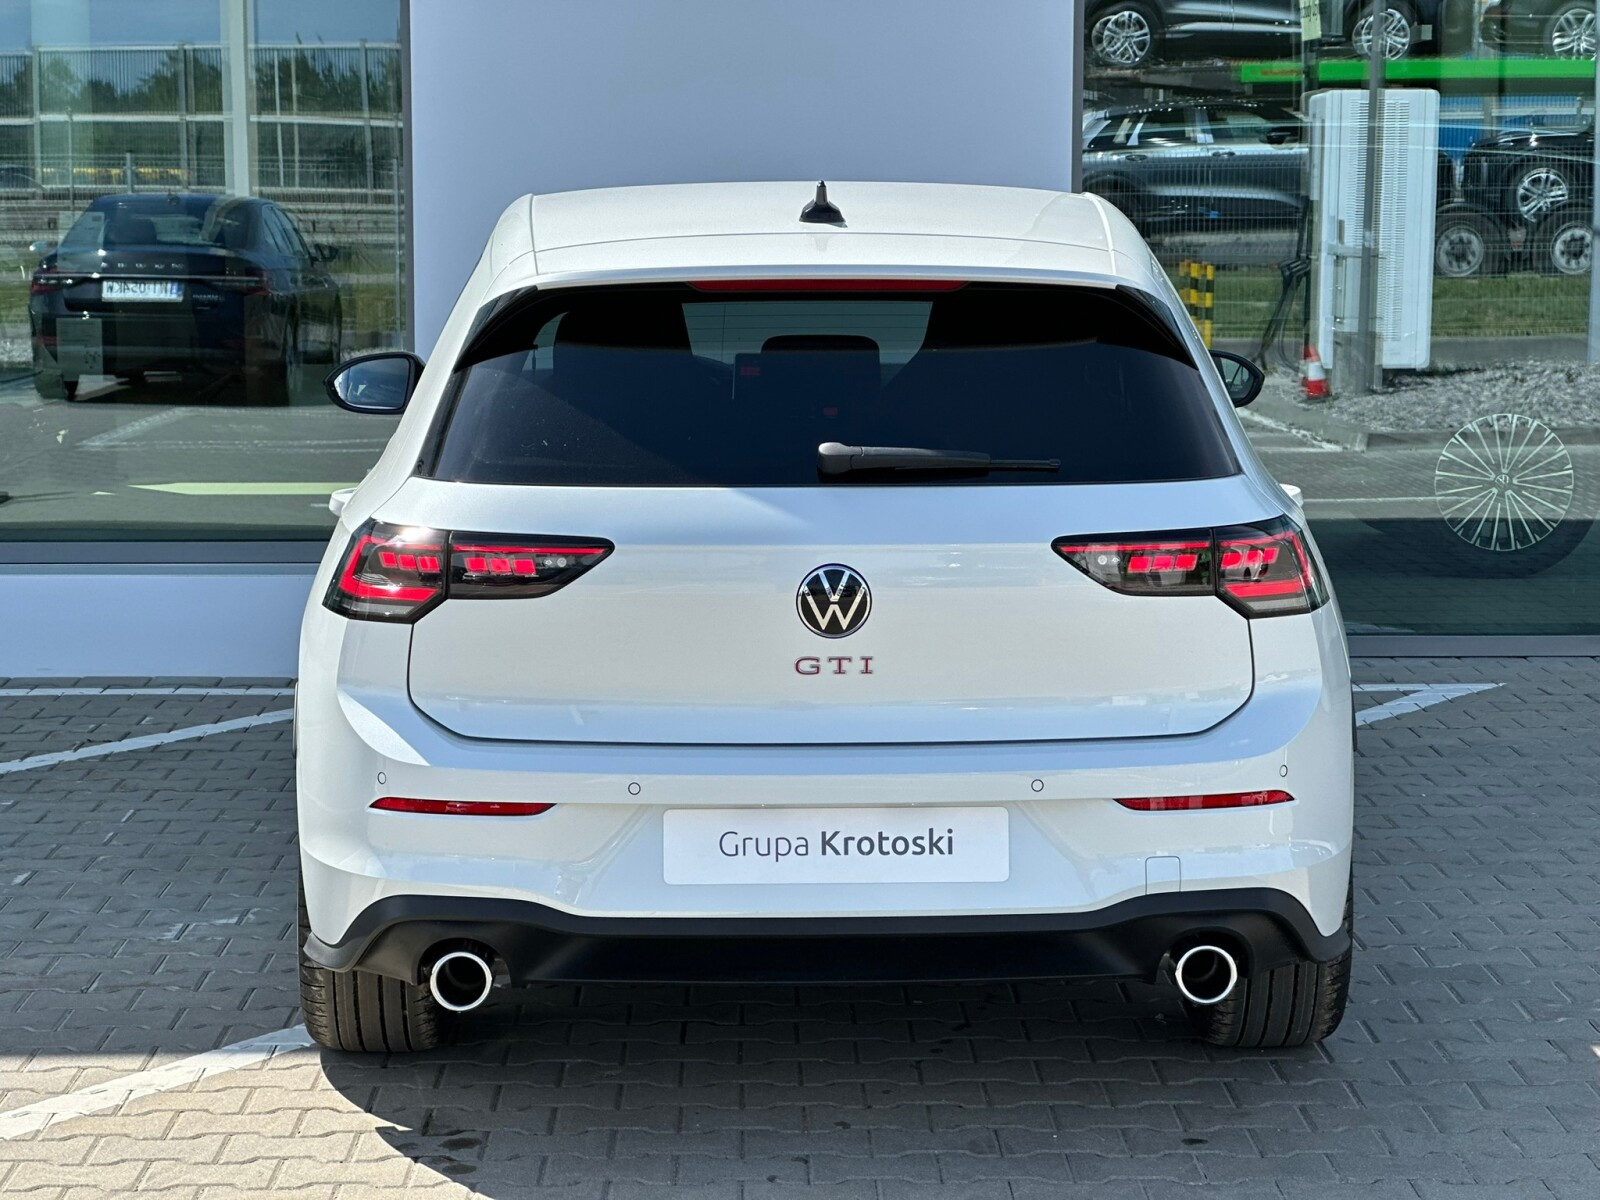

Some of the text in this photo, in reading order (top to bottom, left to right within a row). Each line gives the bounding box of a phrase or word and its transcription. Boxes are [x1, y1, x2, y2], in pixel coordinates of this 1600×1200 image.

[794, 656, 874, 676] GTI
[718, 828, 954, 863] Grupa Krotoski
